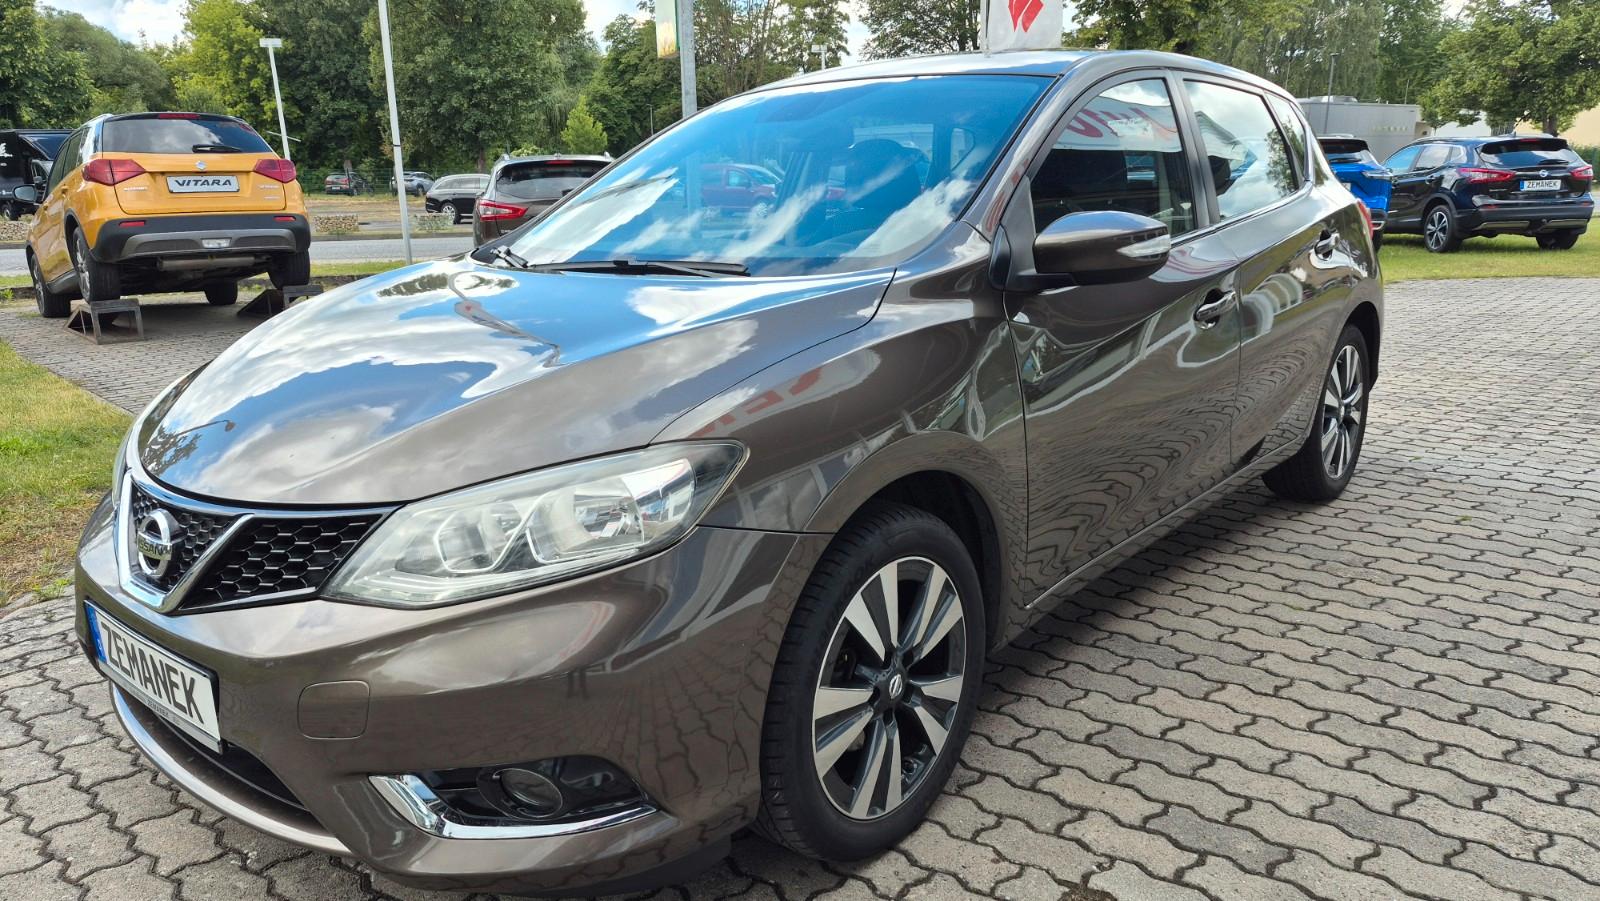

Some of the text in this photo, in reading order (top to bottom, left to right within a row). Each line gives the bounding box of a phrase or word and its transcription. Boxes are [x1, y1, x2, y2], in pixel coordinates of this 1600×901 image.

[174, 179, 232, 187] VITARA
[1527, 181, 1559, 189] ZEMANEK
[101, 621, 205, 725] ZEMANEK
